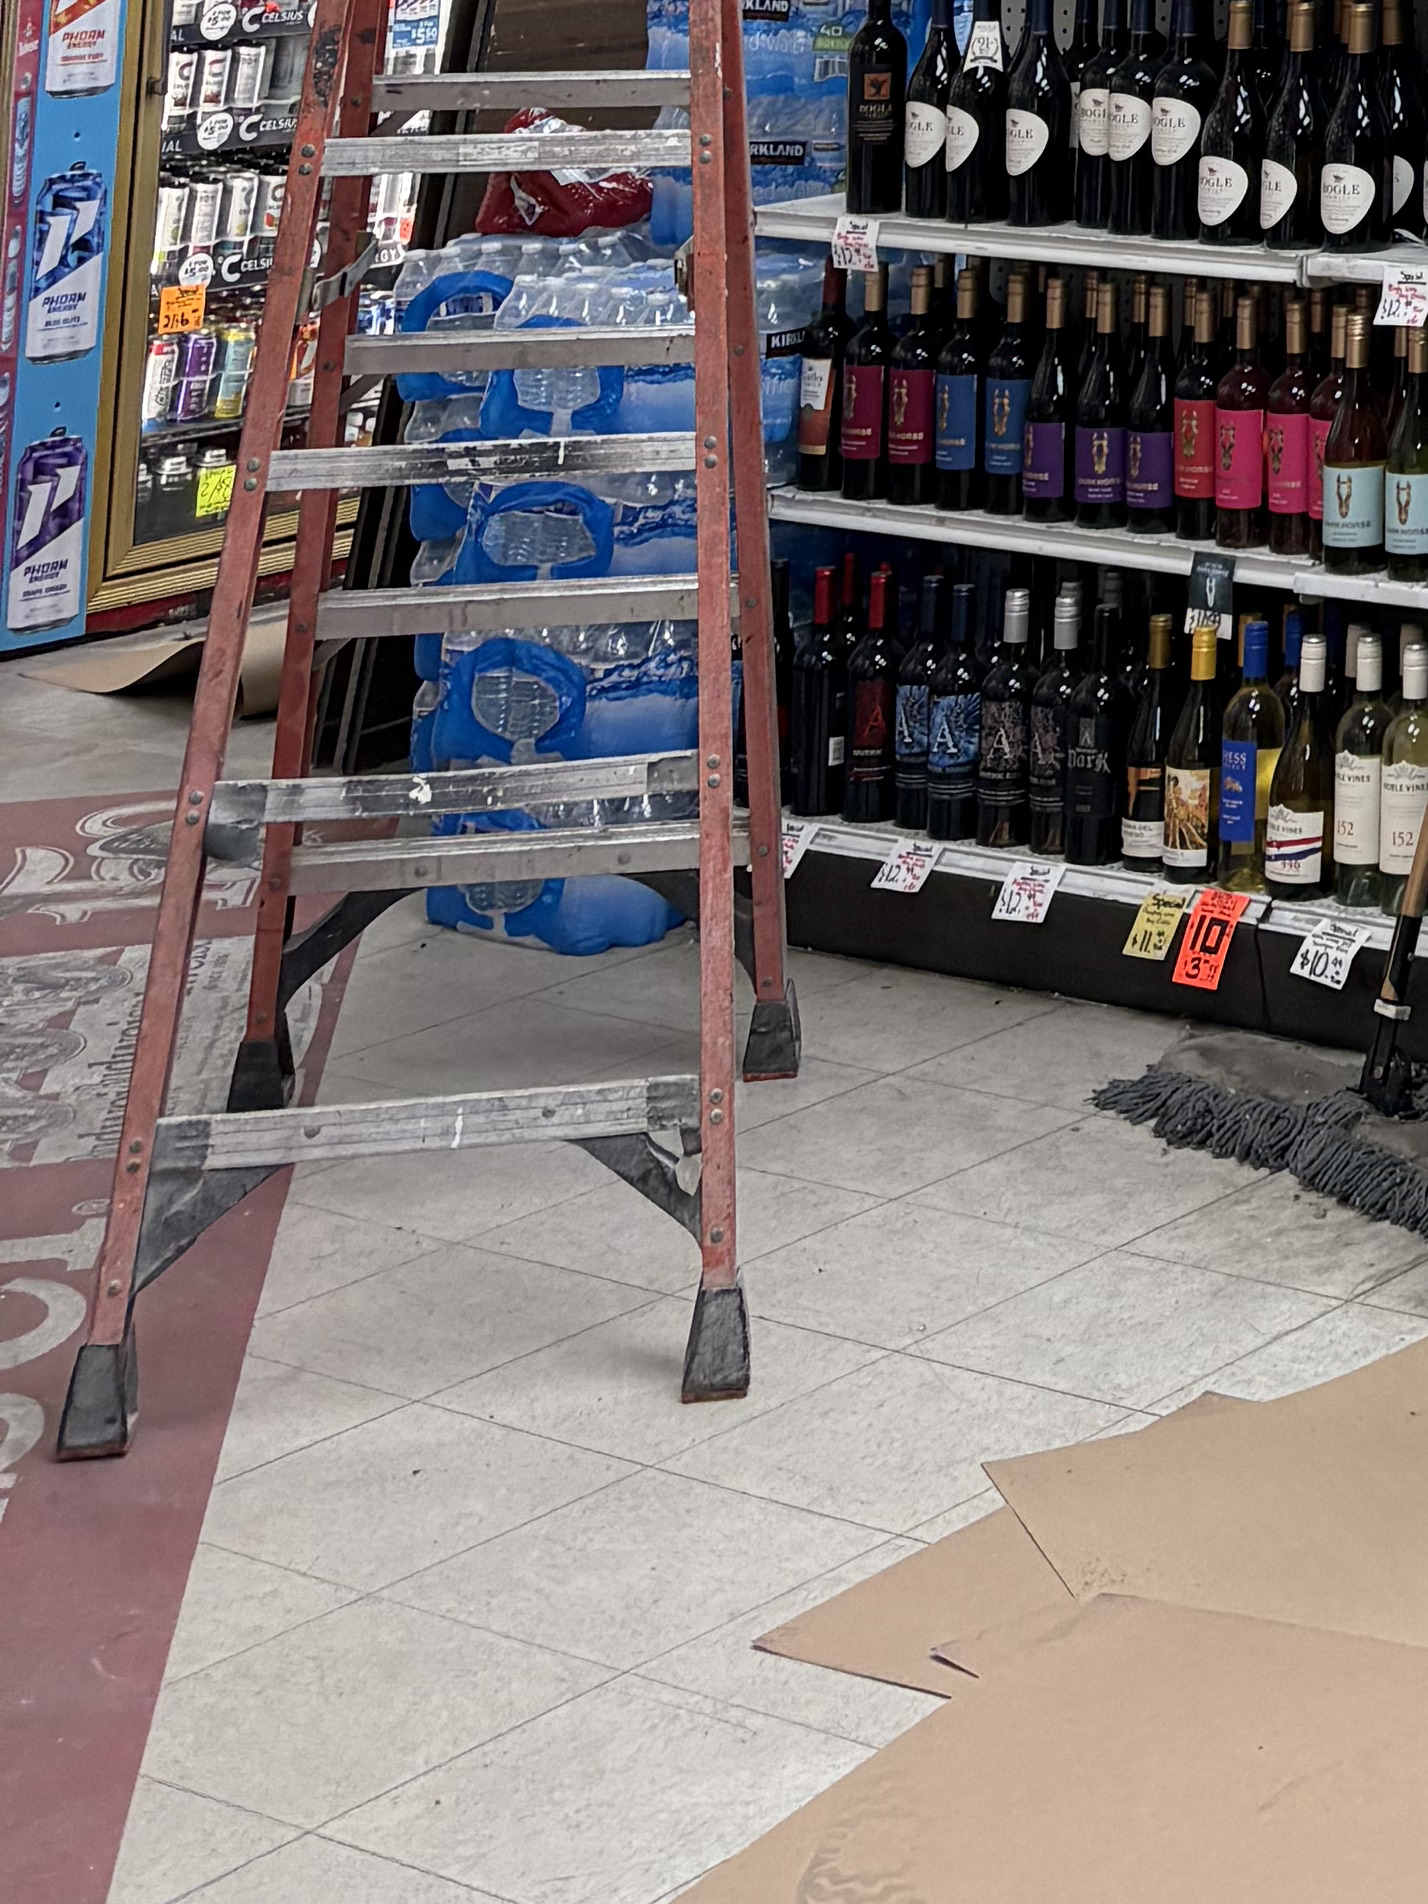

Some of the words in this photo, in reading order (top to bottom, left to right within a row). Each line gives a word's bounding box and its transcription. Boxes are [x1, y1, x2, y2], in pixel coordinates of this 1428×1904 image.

[745, 0, 789, 12] KLAND
[262, 11, 303, 24] CELSIUS
[61, 28, 105, 42] PHORM
[750, 144, 803, 156] RKLAND
[241, 258, 273, 272] CELSI
[42, 292, 87, 307] PHORM
[23, 559, 68, 577] PHORM
[933, 718, 958, 754] A
[989, 728, 1014, 759] A
[1392, 831, 1413, 846] 152
[1152, 893, 1185, 909] Special
